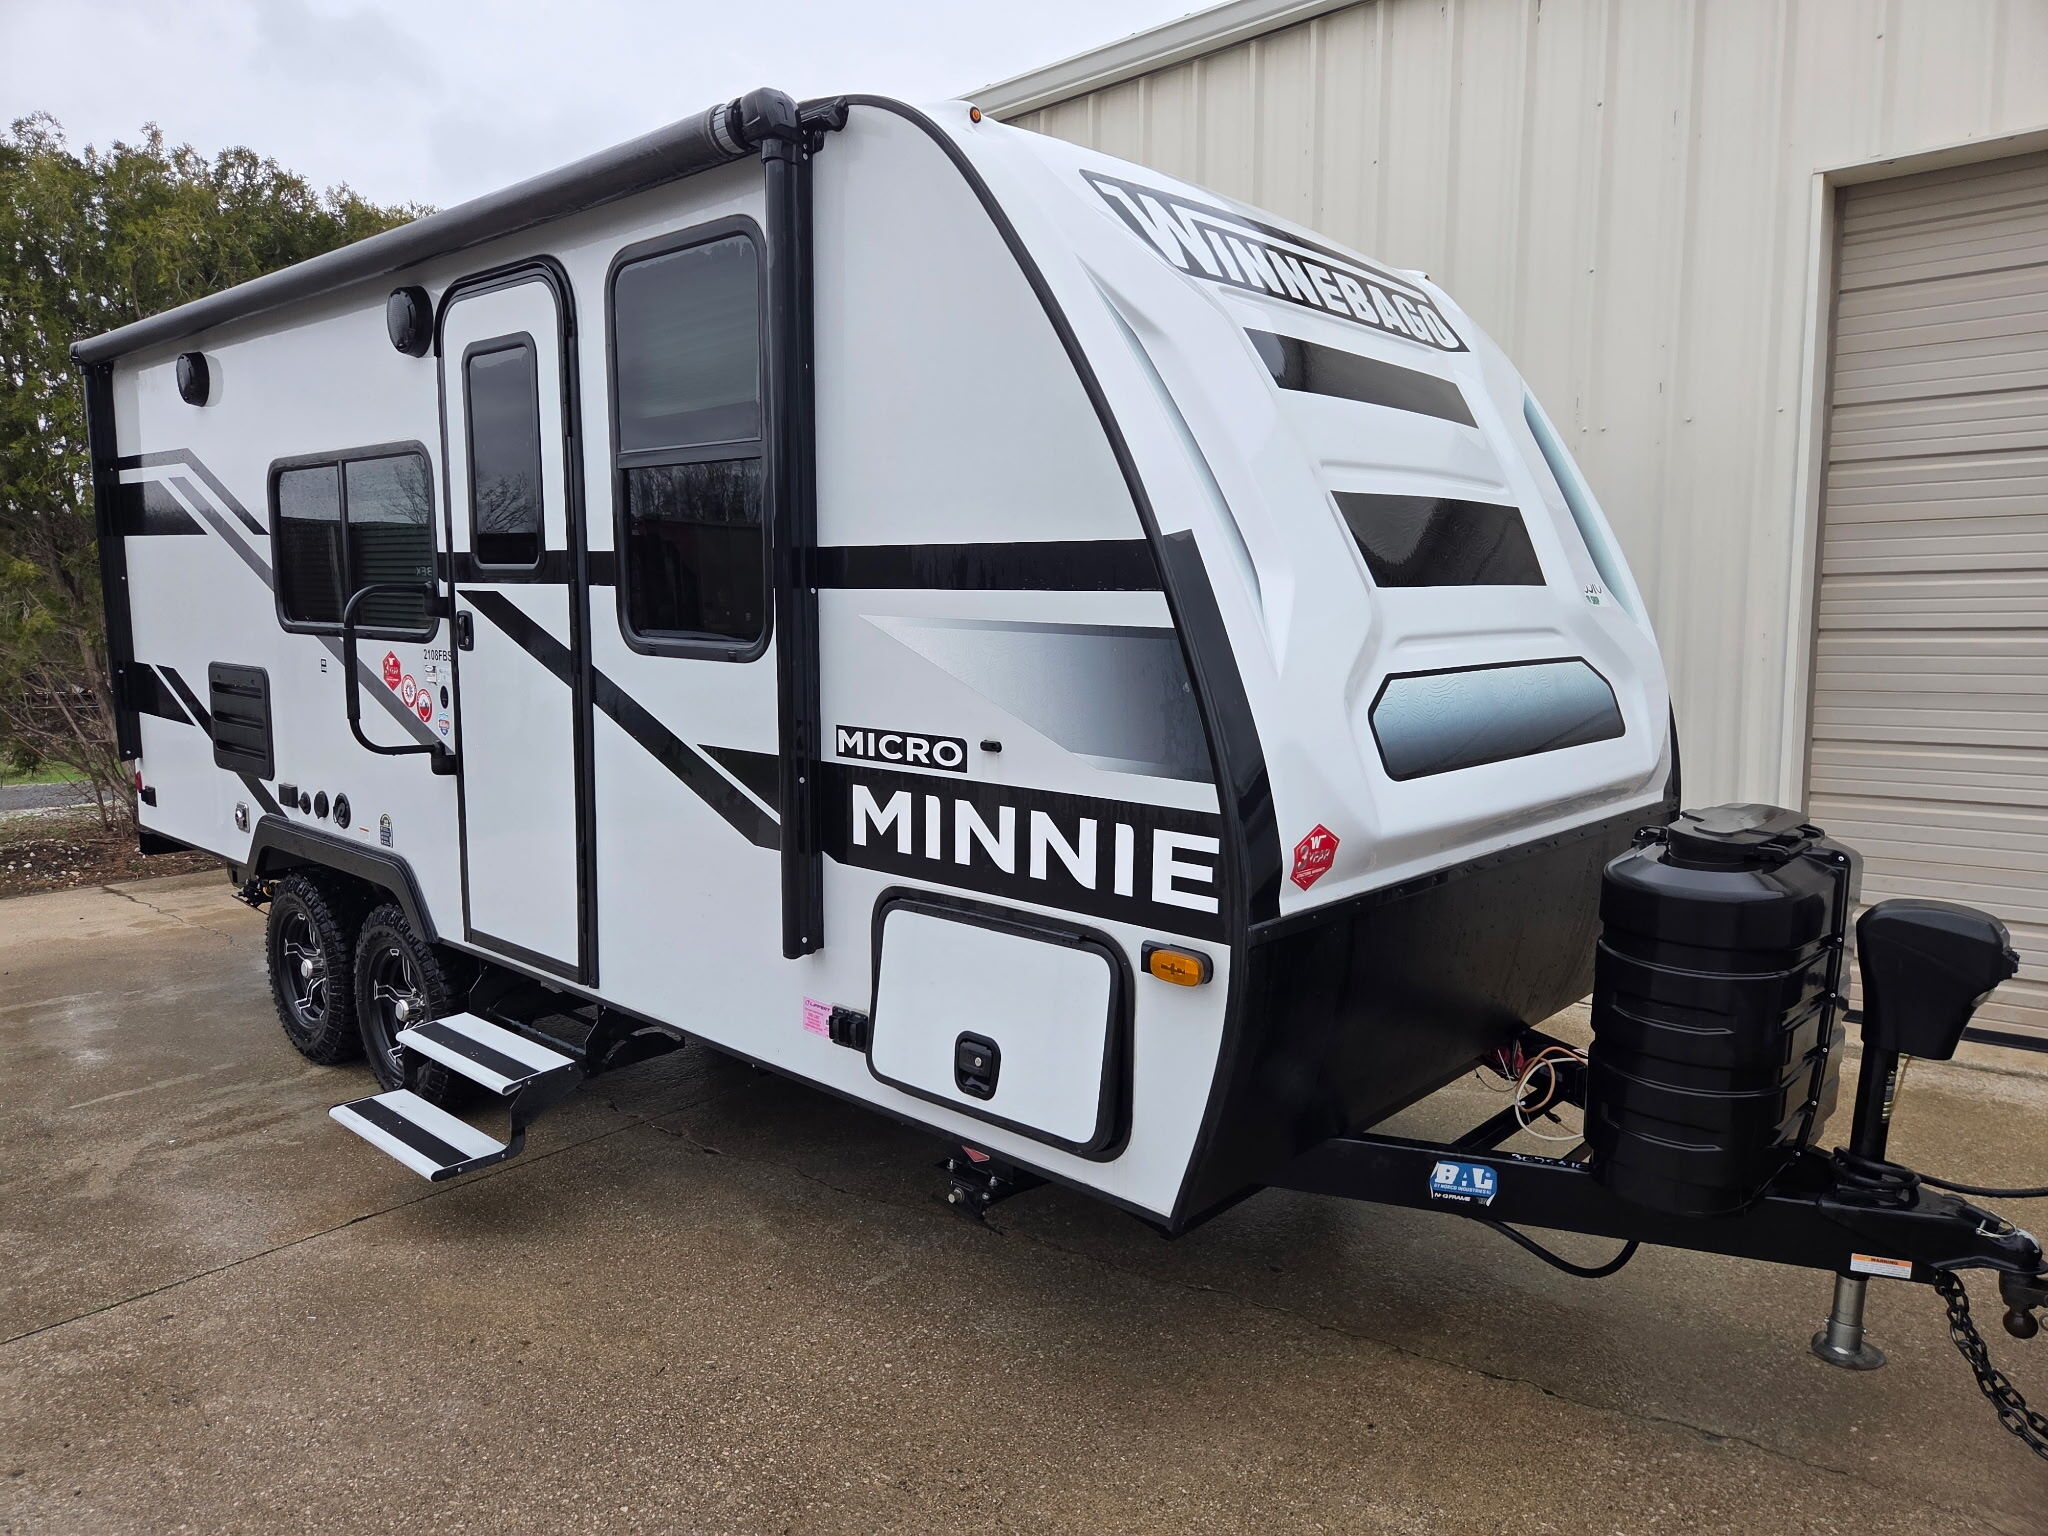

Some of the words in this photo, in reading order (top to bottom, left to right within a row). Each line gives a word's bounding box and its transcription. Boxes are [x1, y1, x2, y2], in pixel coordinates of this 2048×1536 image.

[1091, 179, 1460, 350] WINNEBAGO
[423, 648, 452, 662] 2108FBS
[836, 728, 964, 768] MICRO
[851, 783, 1221, 915] MINNIE
[1434, 1163, 1494, 1190] BAL
[1870, 1256, 1899, 1266] WARNING
